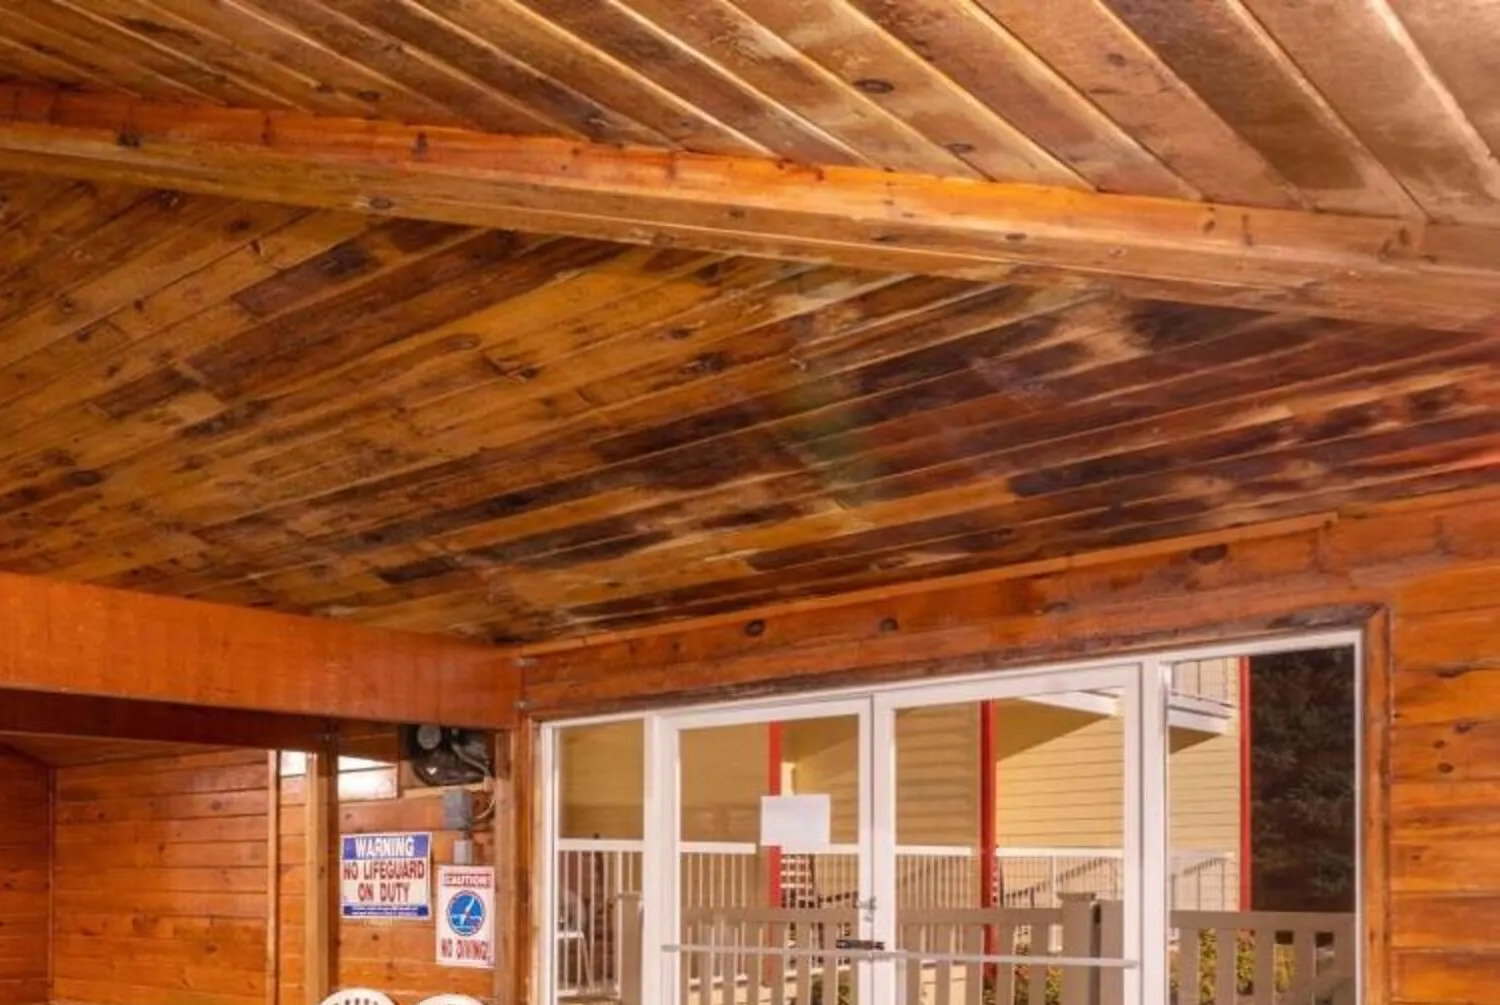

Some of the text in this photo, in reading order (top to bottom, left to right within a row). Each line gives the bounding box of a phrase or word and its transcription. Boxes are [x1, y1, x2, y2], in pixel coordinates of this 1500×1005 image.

[354, 837, 415, 857] WARNING
[343, 860, 425, 880] NO LIFEGUARD
[357, 883, 411, 902] ON DUTY
[441, 938, 453, 958] NO
